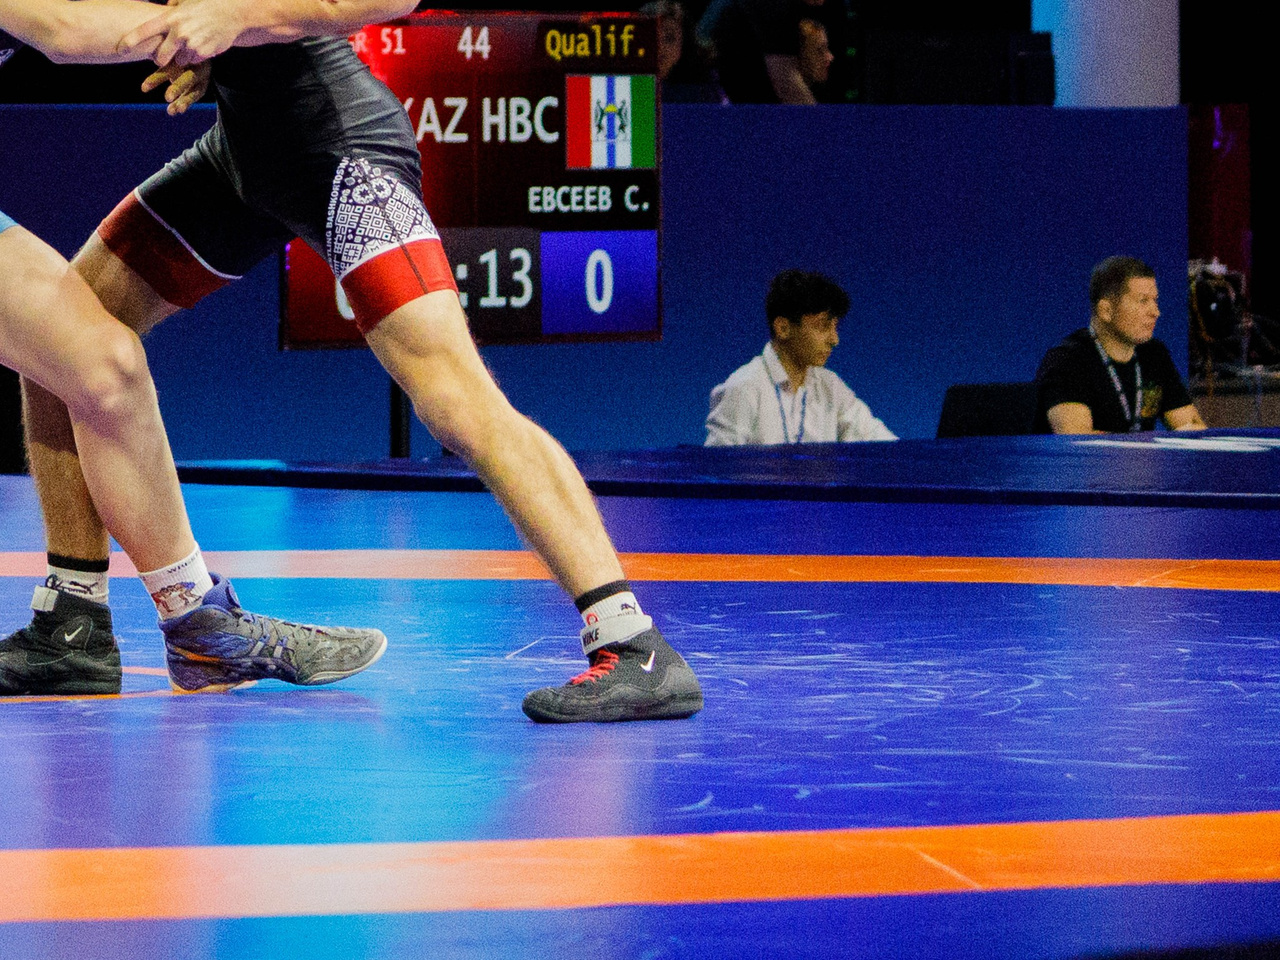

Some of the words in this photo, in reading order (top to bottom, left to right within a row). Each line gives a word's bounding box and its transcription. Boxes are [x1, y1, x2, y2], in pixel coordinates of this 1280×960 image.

[349, 31, 367, 54] R
[381, 27, 406, 55] 51
[457, 26, 491, 60] 44
[545, 25, 646, 61] Qualif.
[528, 186, 612, 213] ЕВСЕЕВ
[624, 186, 650, 211] С.
[585, 249, 614, 314] 0
